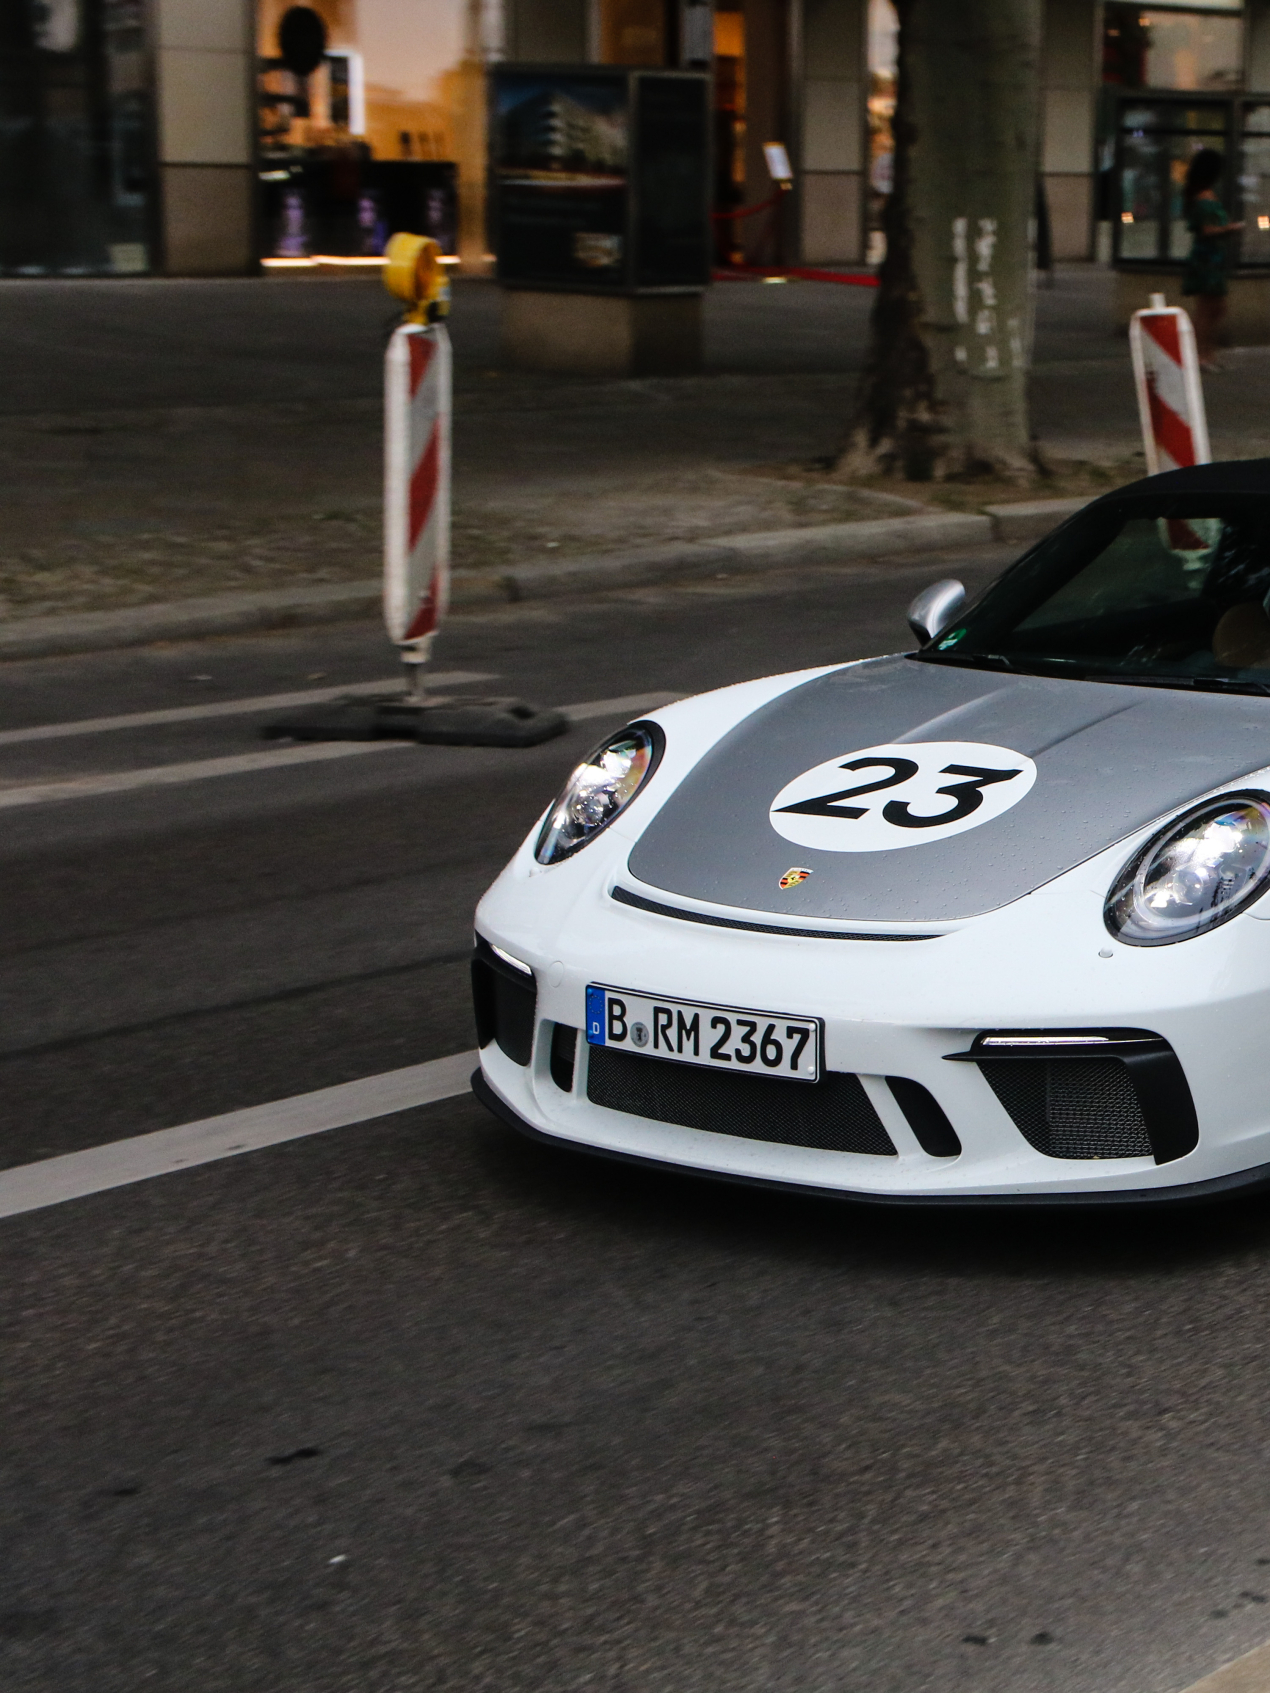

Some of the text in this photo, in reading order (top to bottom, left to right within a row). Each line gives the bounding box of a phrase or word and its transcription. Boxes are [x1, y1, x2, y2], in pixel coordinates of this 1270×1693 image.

[771, 757, 1024, 828] 23
[608, 997, 810, 1071] B RM 2367
